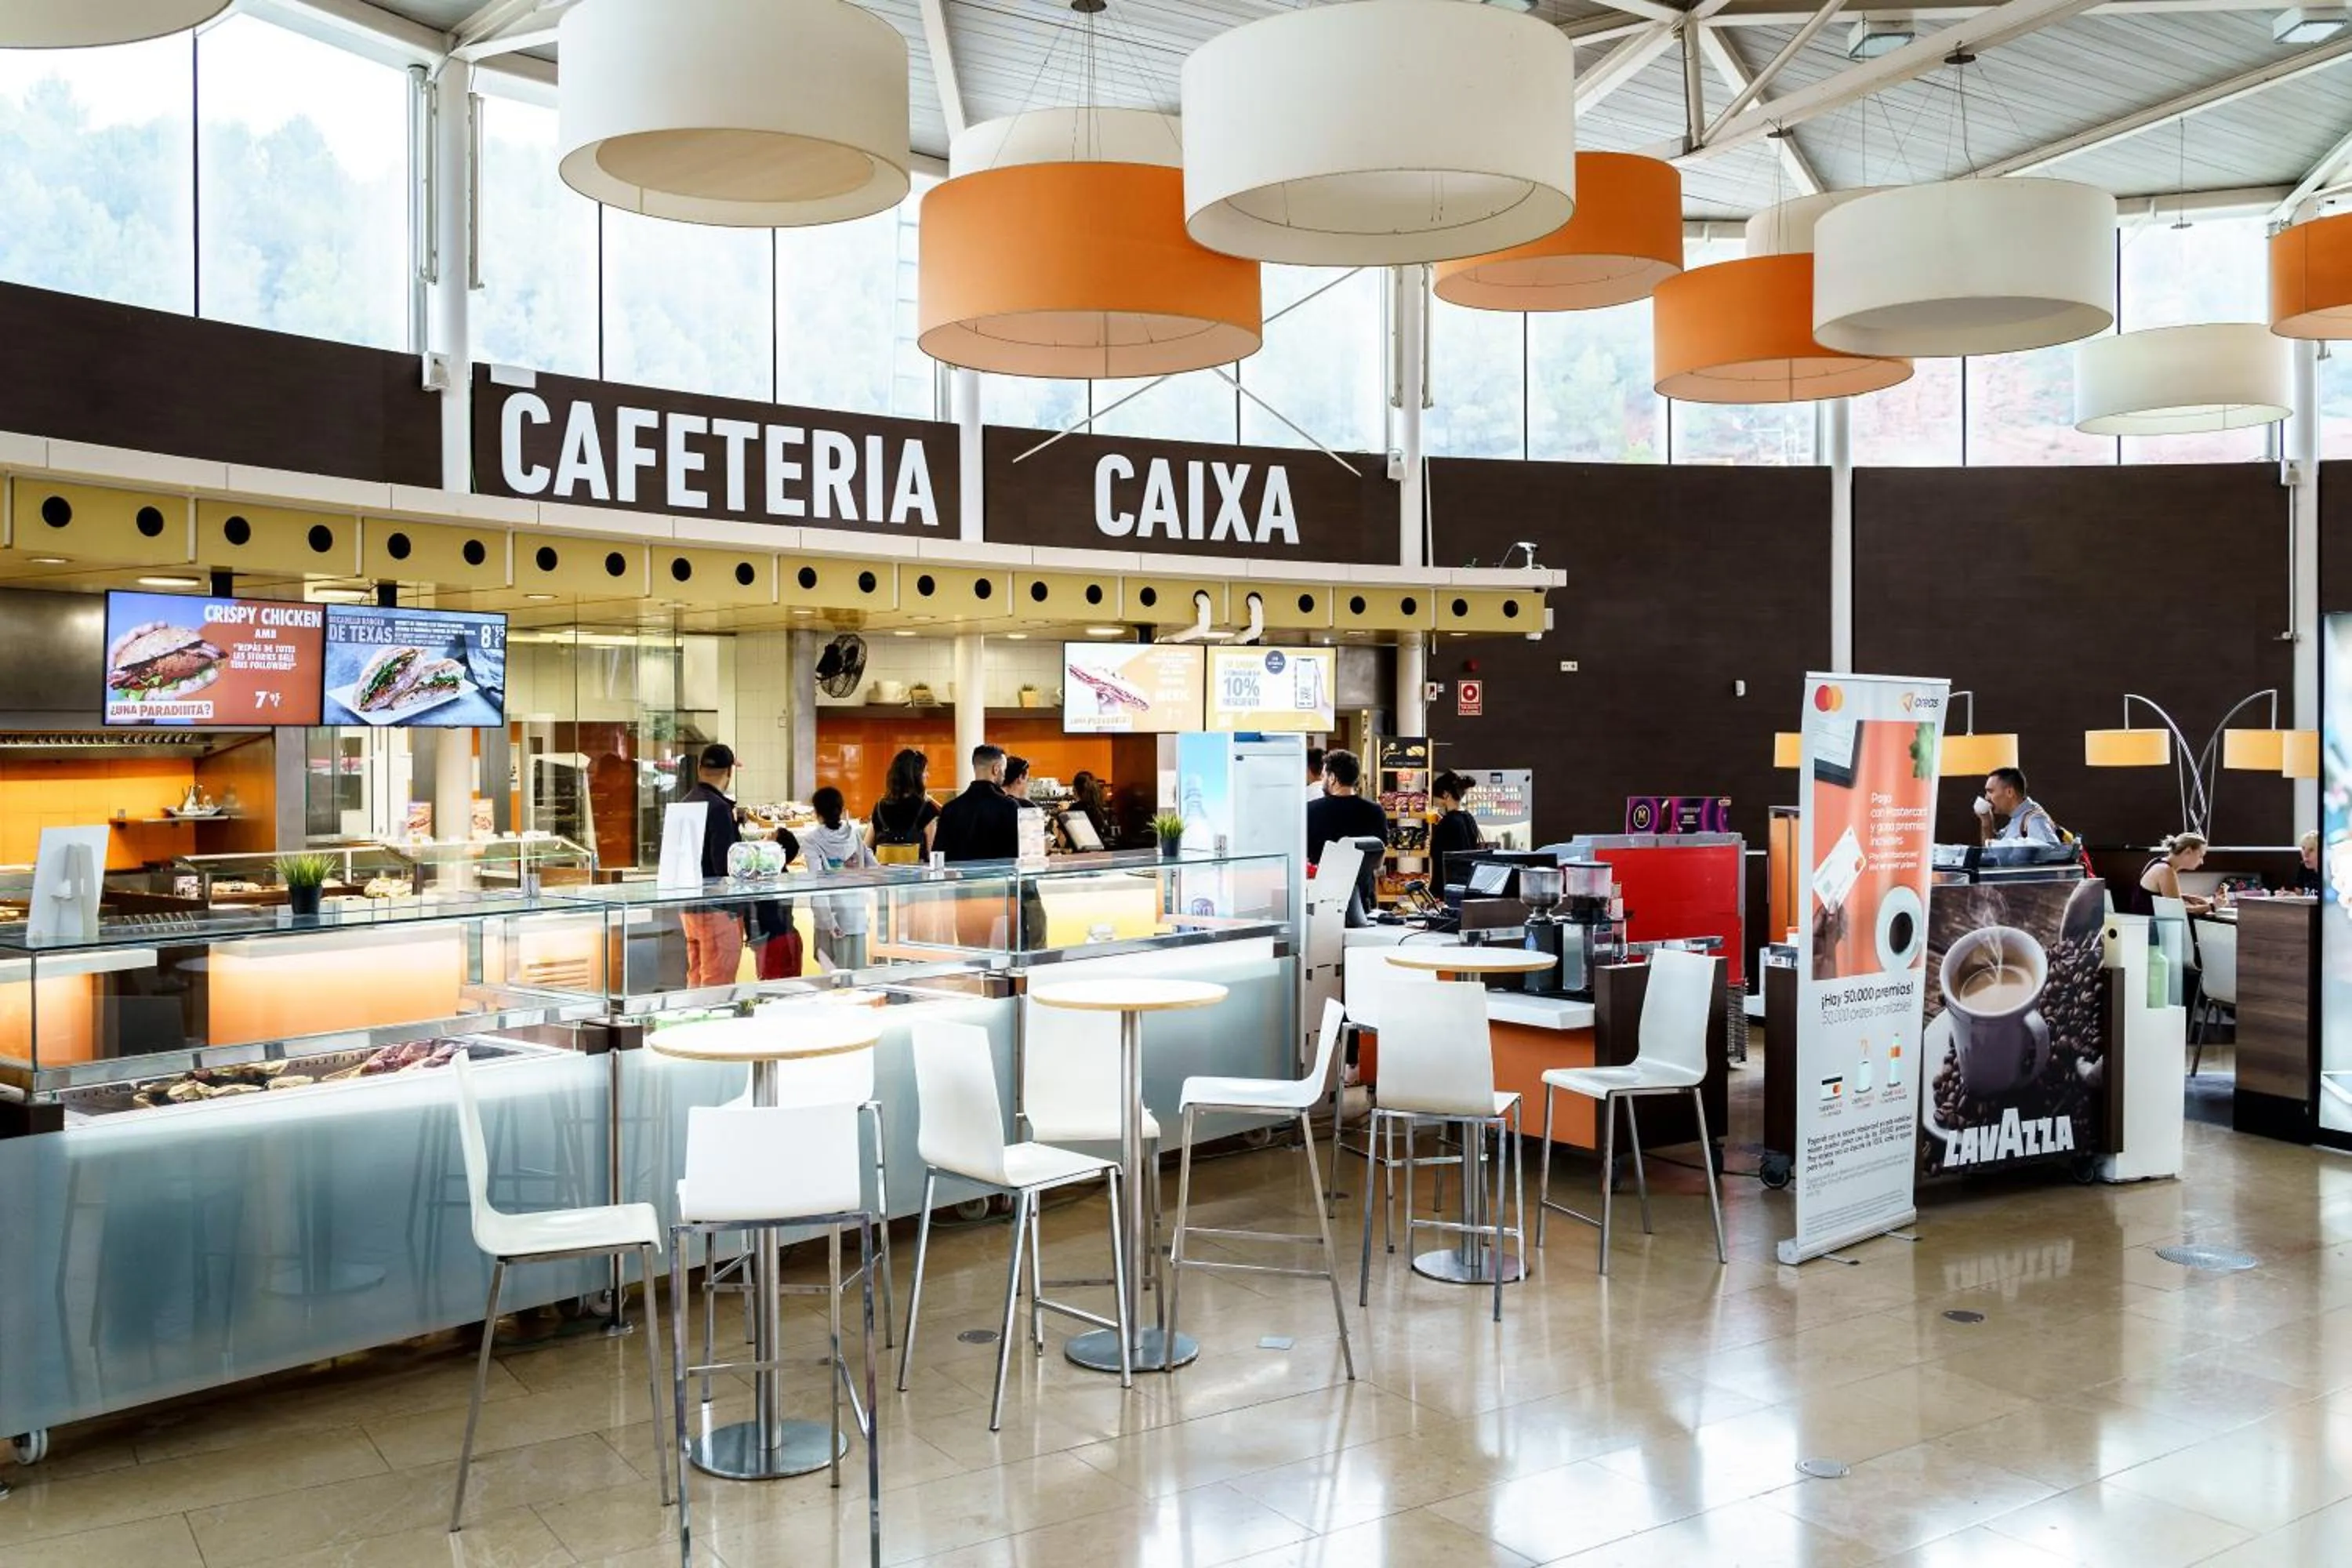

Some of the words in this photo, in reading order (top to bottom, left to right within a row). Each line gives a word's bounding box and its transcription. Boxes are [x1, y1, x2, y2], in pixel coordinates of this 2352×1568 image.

[500, 392, 940, 526] CAFETERIA
[1094, 453, 1300, 544] CAIXA
[204, 604, 257, 625] CRISPY
[261, 608, 322, 628] CHICKEN
[328, 624, 347, 642] DE
[349, 625, 393, 644] TEXAS
[1224, 677, 1260, 697] 10%
[1820, 993, 1842, 1011] ¡Hay
[1843, 986, 1875, 1004] 50.000
[1875, 981, 1914, 1001] premios!
[1942, 1107, 2075, 1168] LAVAZZA
